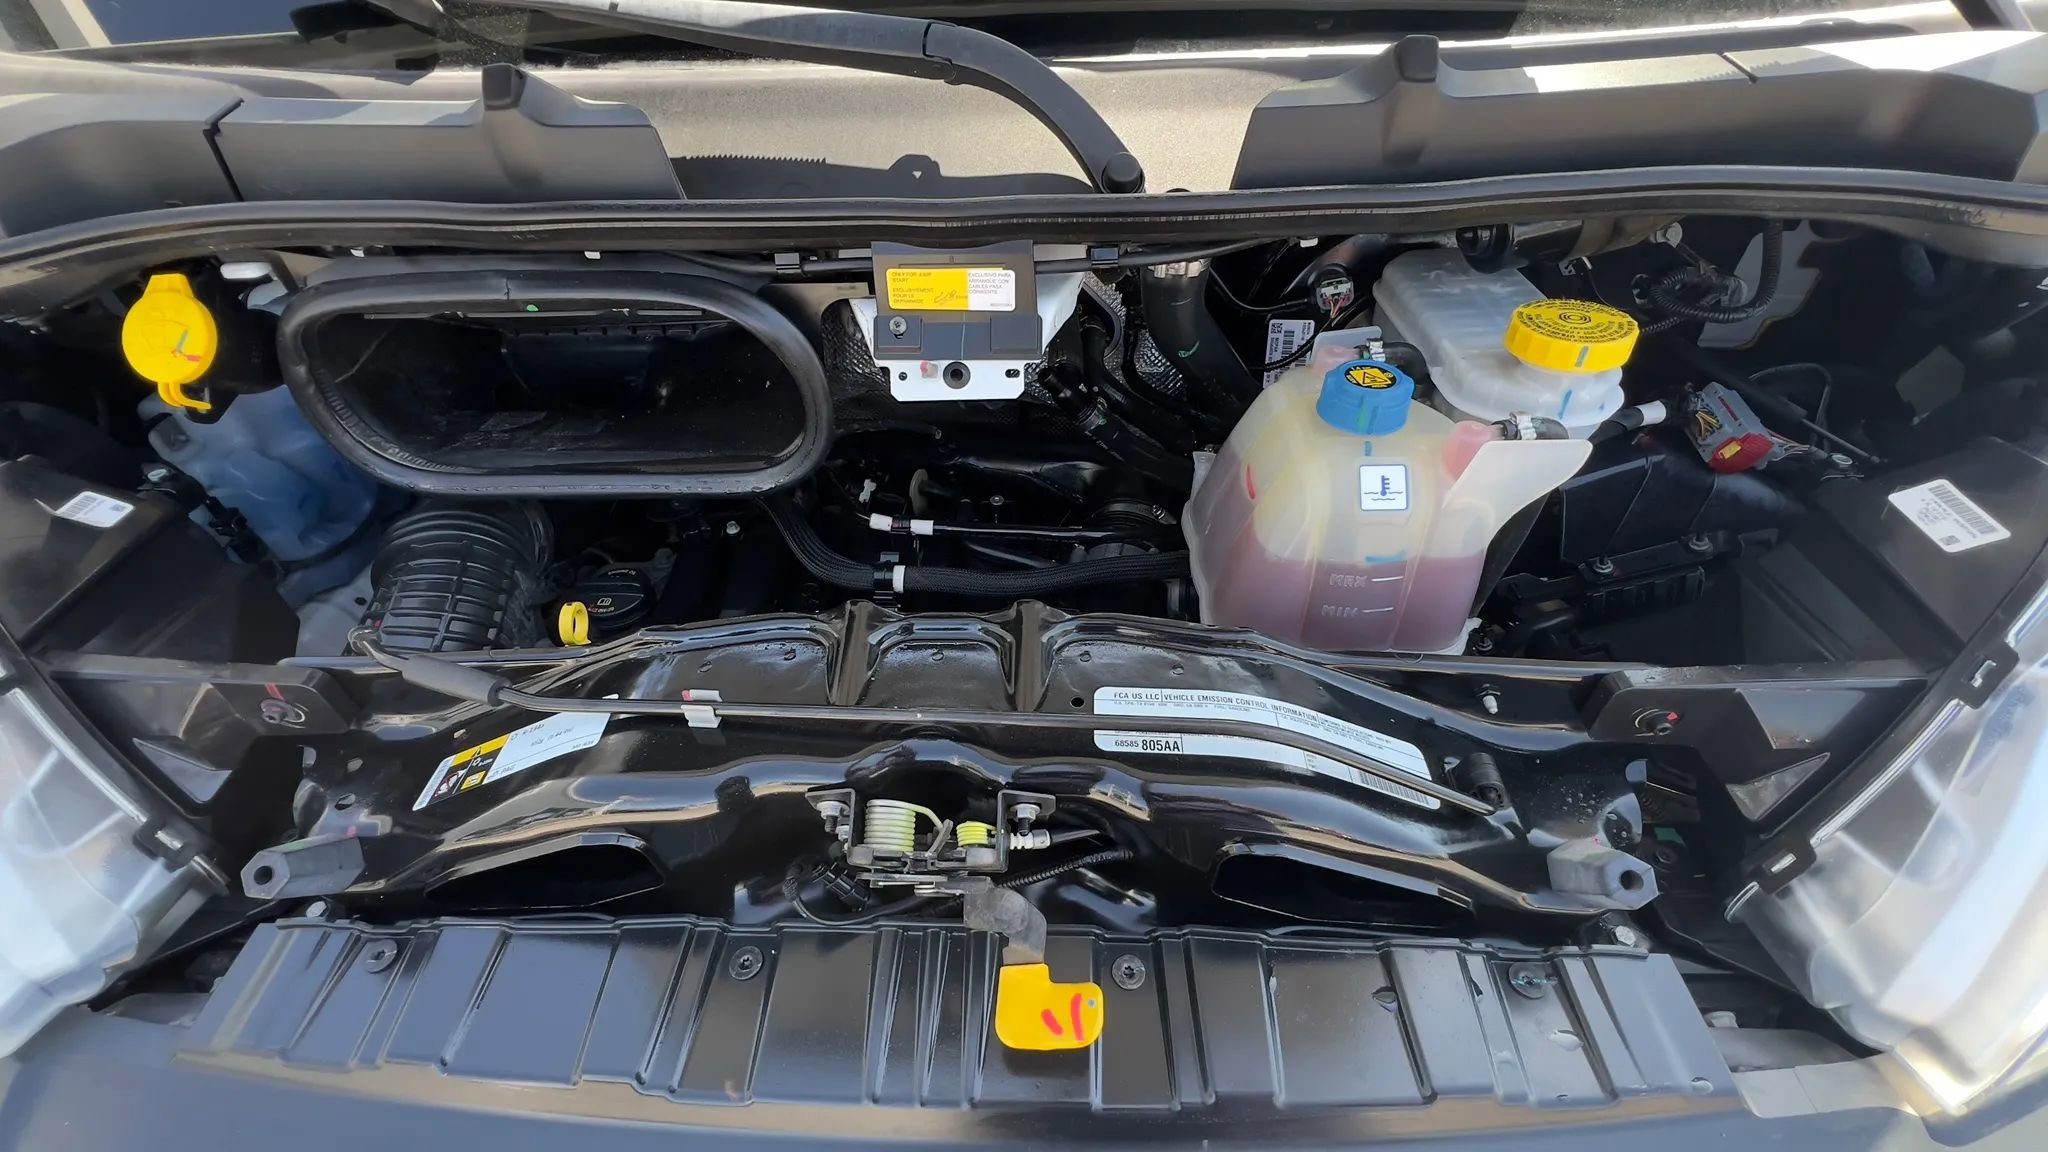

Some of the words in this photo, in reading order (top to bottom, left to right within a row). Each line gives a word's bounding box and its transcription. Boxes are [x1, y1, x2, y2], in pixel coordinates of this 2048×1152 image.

[1113, 692, 1129, 700] FCA
[1145, 693, 1160, 701] LLC
[1163, 693, 1194, 702] VEHICLE
[1197, 694, 1233, 704] EMISSION
[1235, 697, 1269, 711] CONTROL
[1270, 704, 1318, 723] INFORMATION
[1114, 740, 1139, 748] 68585
[1141, 738, 1181, 753] 805AA
